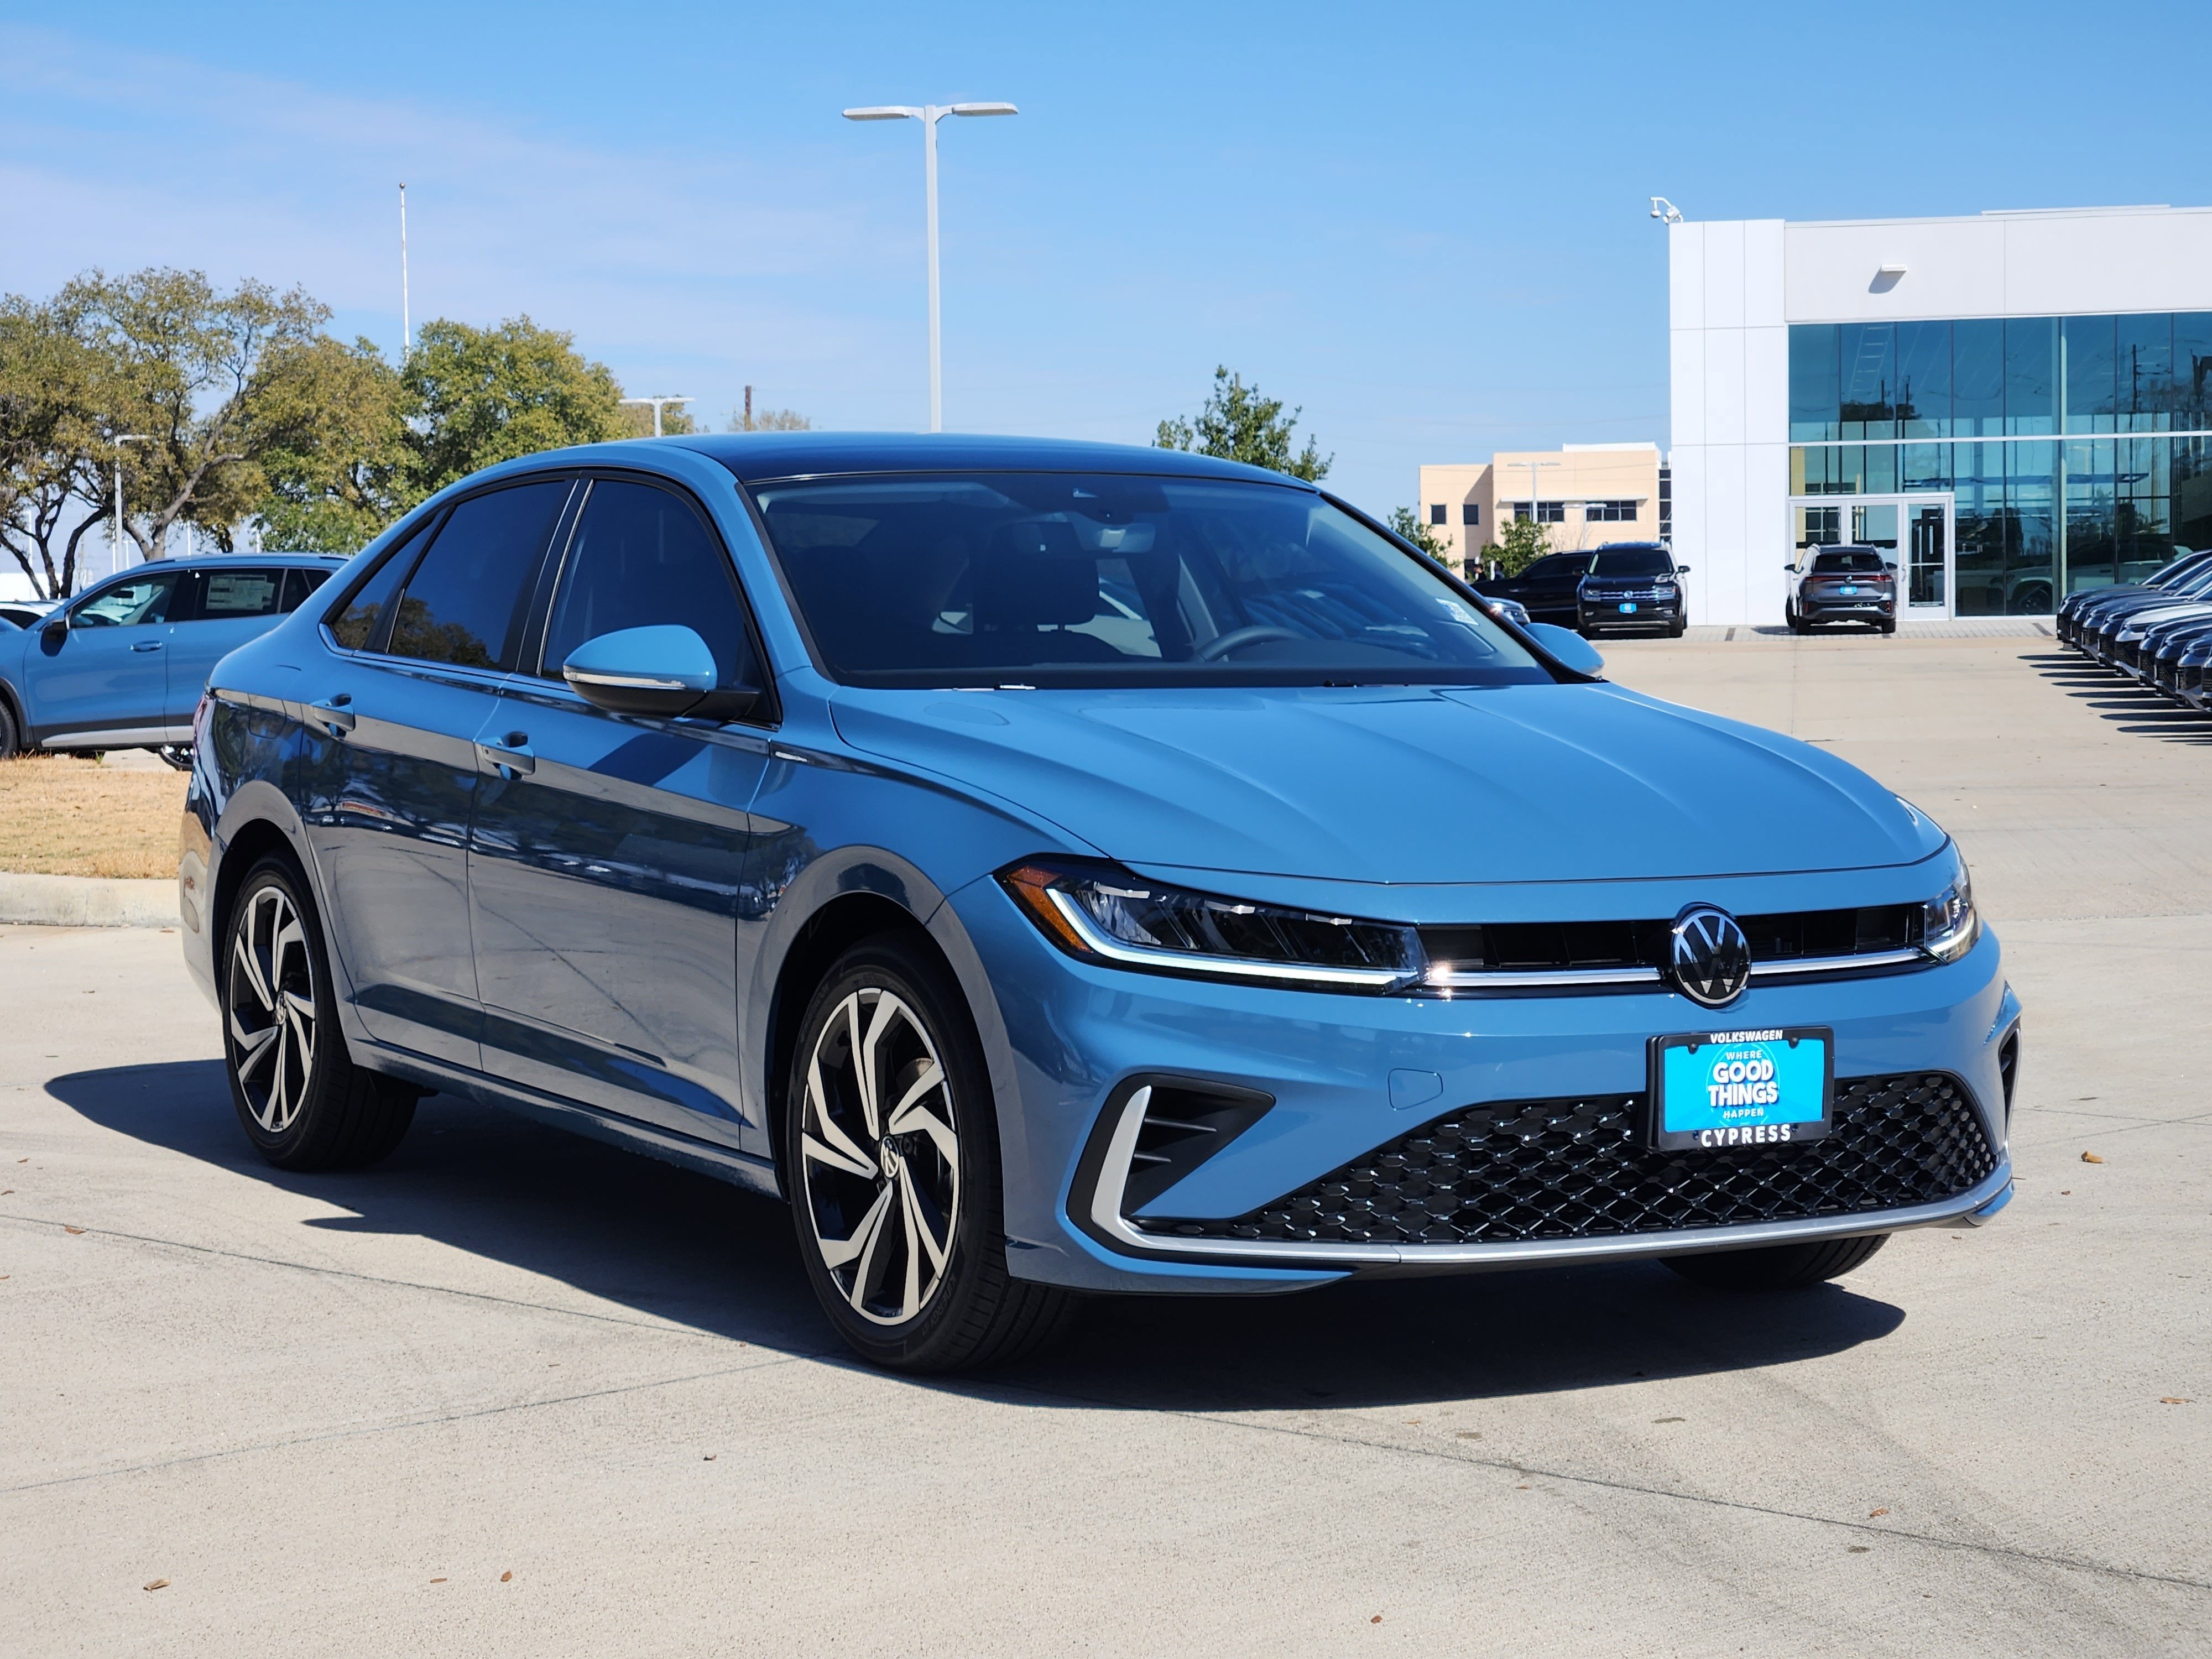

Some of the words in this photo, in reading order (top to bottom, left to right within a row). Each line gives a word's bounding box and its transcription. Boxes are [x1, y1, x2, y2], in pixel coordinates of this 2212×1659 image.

[1710, 1030, 1783, 1044] VOLKSWAGEN
[1726, 1050, 1763, 1060] WHERE
[1713, 1059, 1773, 1084] GOOD
[1708, 1081, 1779, 1107] THINGS
[1723, 1108, 1764, 1119] HAPPEN
[1701, 1124, 1791, 1147] CYPRESS
